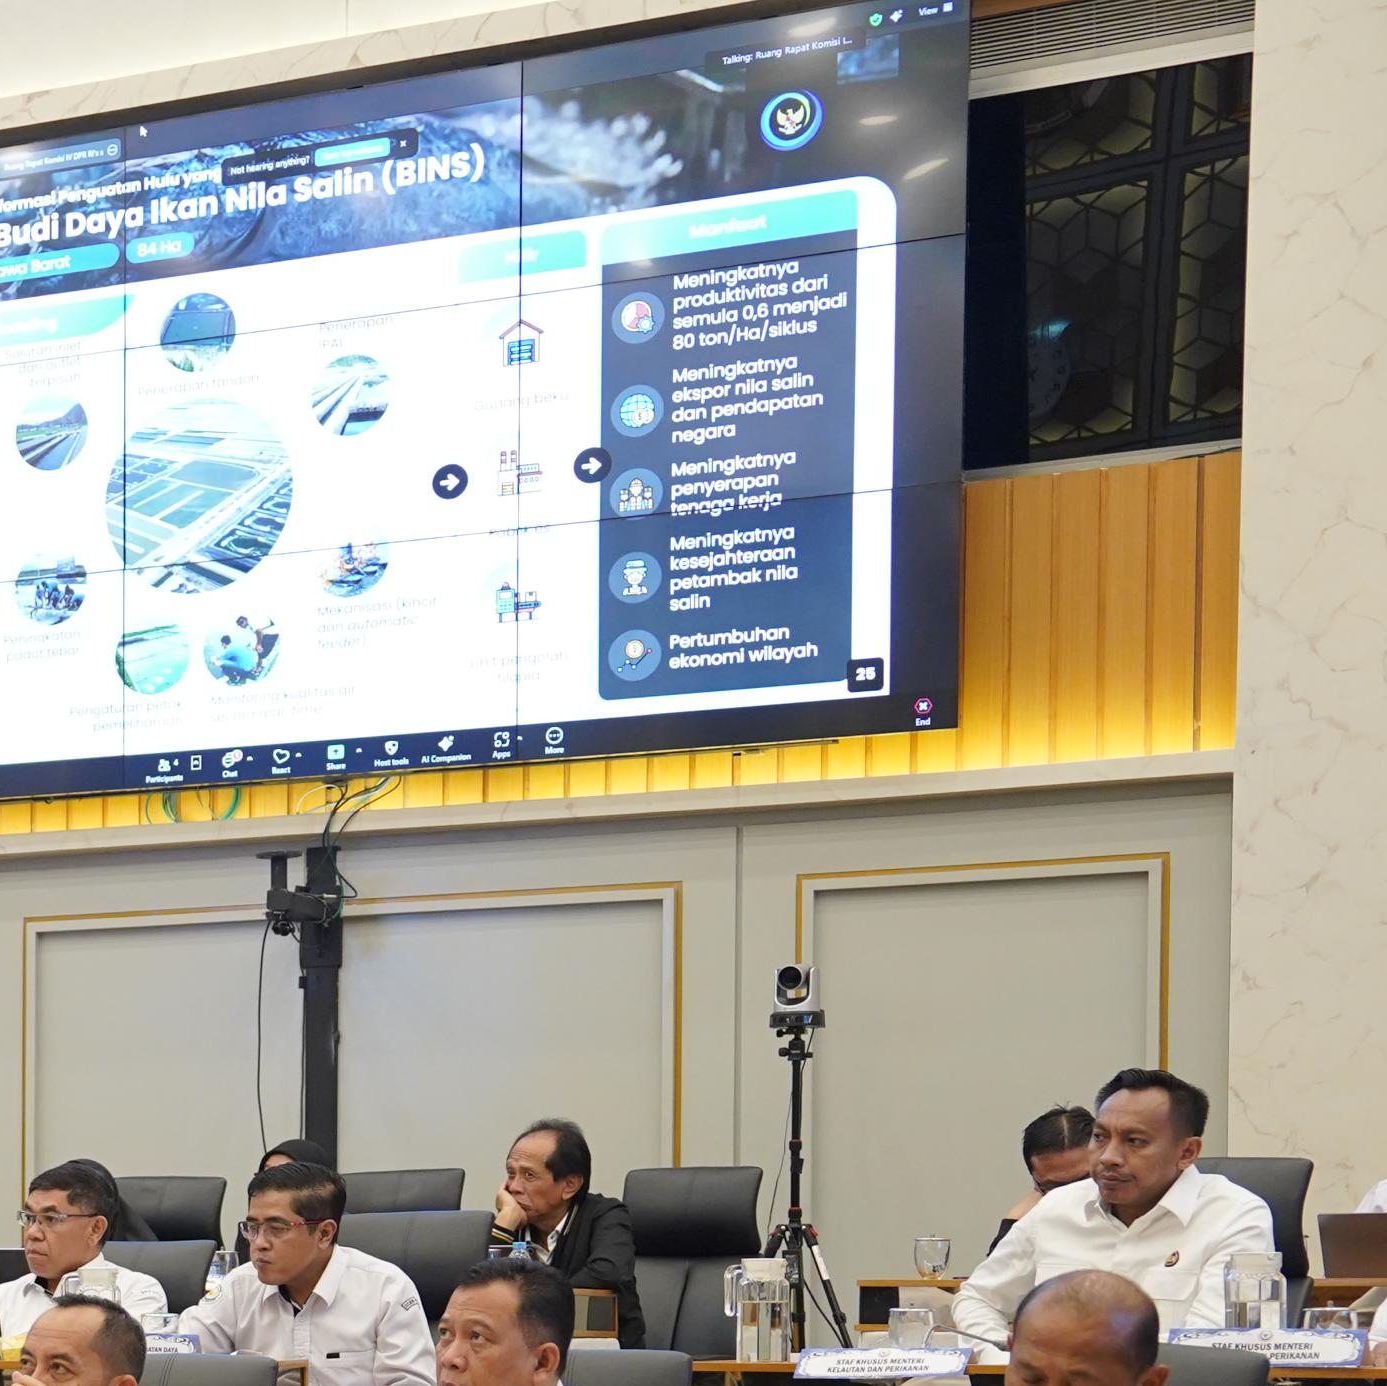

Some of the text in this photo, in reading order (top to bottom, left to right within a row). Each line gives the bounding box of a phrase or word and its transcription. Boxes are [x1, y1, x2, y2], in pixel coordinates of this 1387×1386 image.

[918, 6, 938, 17] View
[722, 36, 841, 66] Talking: Ruang Rapat Komisi
[230, 154, 311, 176] Not hearing anything?
[58, 179, 141, 210] Penguatan
[144, 172, 180, 192] Hulu
[182, 167, 221, 190] yang
[66, 204, 144, 239] Daya
[151, 192, 219, 225] Ikan
[226, 181, 287, 213] Nila
[293, 166, 374, 202] Salin
[382, 143, 485, 194] (BINS)
[689, 214, 767, 239] Manfaat
[137, 237, 183, 258] 84 Ha
[31, 254, 71, 274] Barat
[673, 261, 799, 290] Meningkatnya
[673, 274, 828, 314] produktivitas dari
[672, 291, 848, 330] semula 0,6 menjadi
[672, 318, 818, 351] 80 ton/Ha/siklus
[672, 355, 798, 384] Meningkatnya
[672, 372, 814, 404] ekspor nila salin
[672, 391, 824, 424] dan pendapatan
[672, 422, 736, 446] negara
[671, 451, 797, 477] Meningkatnya
[671, 473, 779, 501] penyerapan
[671, 490, 782, 517] tenaga kerja
[670, 526, 795, 552] Meningkatnya
[670, 545, 795, 572] kesejahteraan
[670, 564, 798, 595] petambak nila
[670, 593, 711, 612] salin
[669, 625, 790, 650] Pertumbuhan
[669, 642, 818, 670] ekonomi wilayah
[855, 667, 876, 682] 25
[915, 717, 931, 726] End
[373, 756, 409, 768] Host tools
[421, 752, 472, 764] AI Companion
[492, 749, 512, 760] Apps
[544, 744, 566, 755] More
[222, 768, 239, 778] Chat
[271, 765, 291, 775] React
[326, 761, 346, 771] Share
[145, 773, 184, 785] Participants
[1235, 1343, 1272, 1351] KHUSUS
[1269, 1352, 1321, 1360] PERIKANAN
